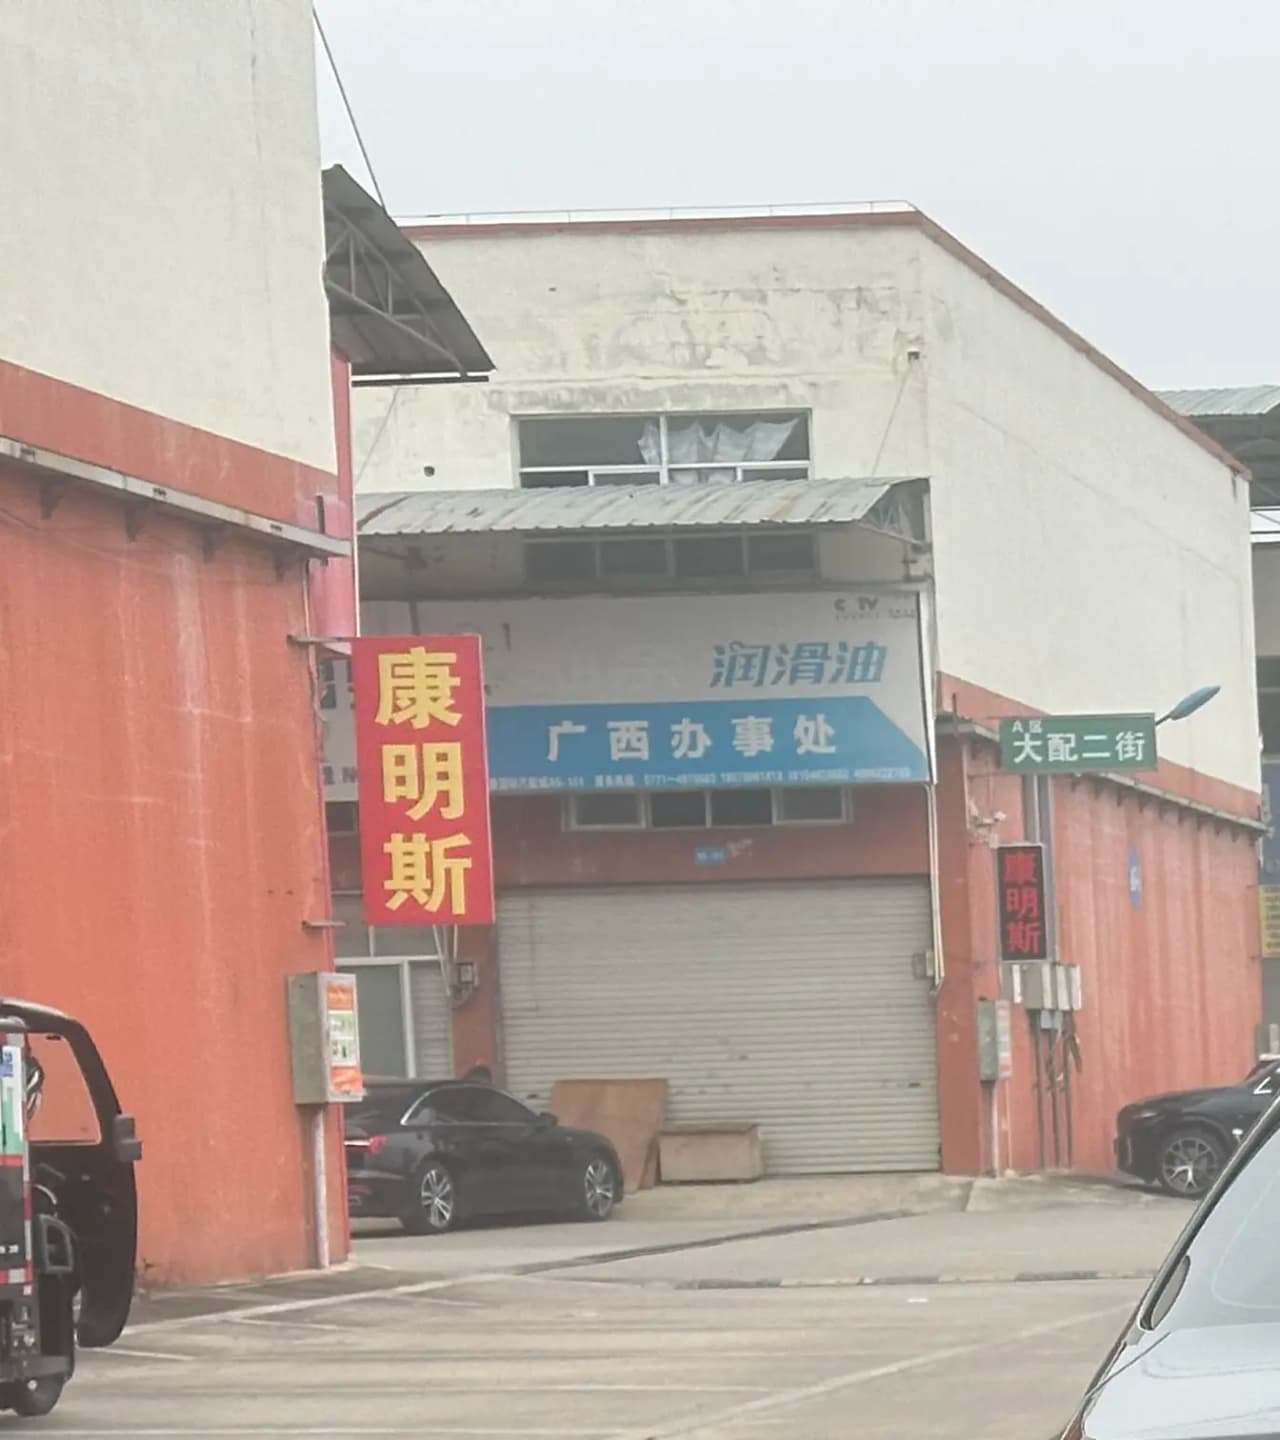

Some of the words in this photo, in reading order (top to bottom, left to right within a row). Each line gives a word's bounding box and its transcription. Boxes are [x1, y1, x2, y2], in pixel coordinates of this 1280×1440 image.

[709, 640, 888, 688] 润滑油
[547, 713, 837, 762] 广西办事处
[1013, 731, 1146, 764] 大配二街
[375, 646, 472, 915] 康明斯
